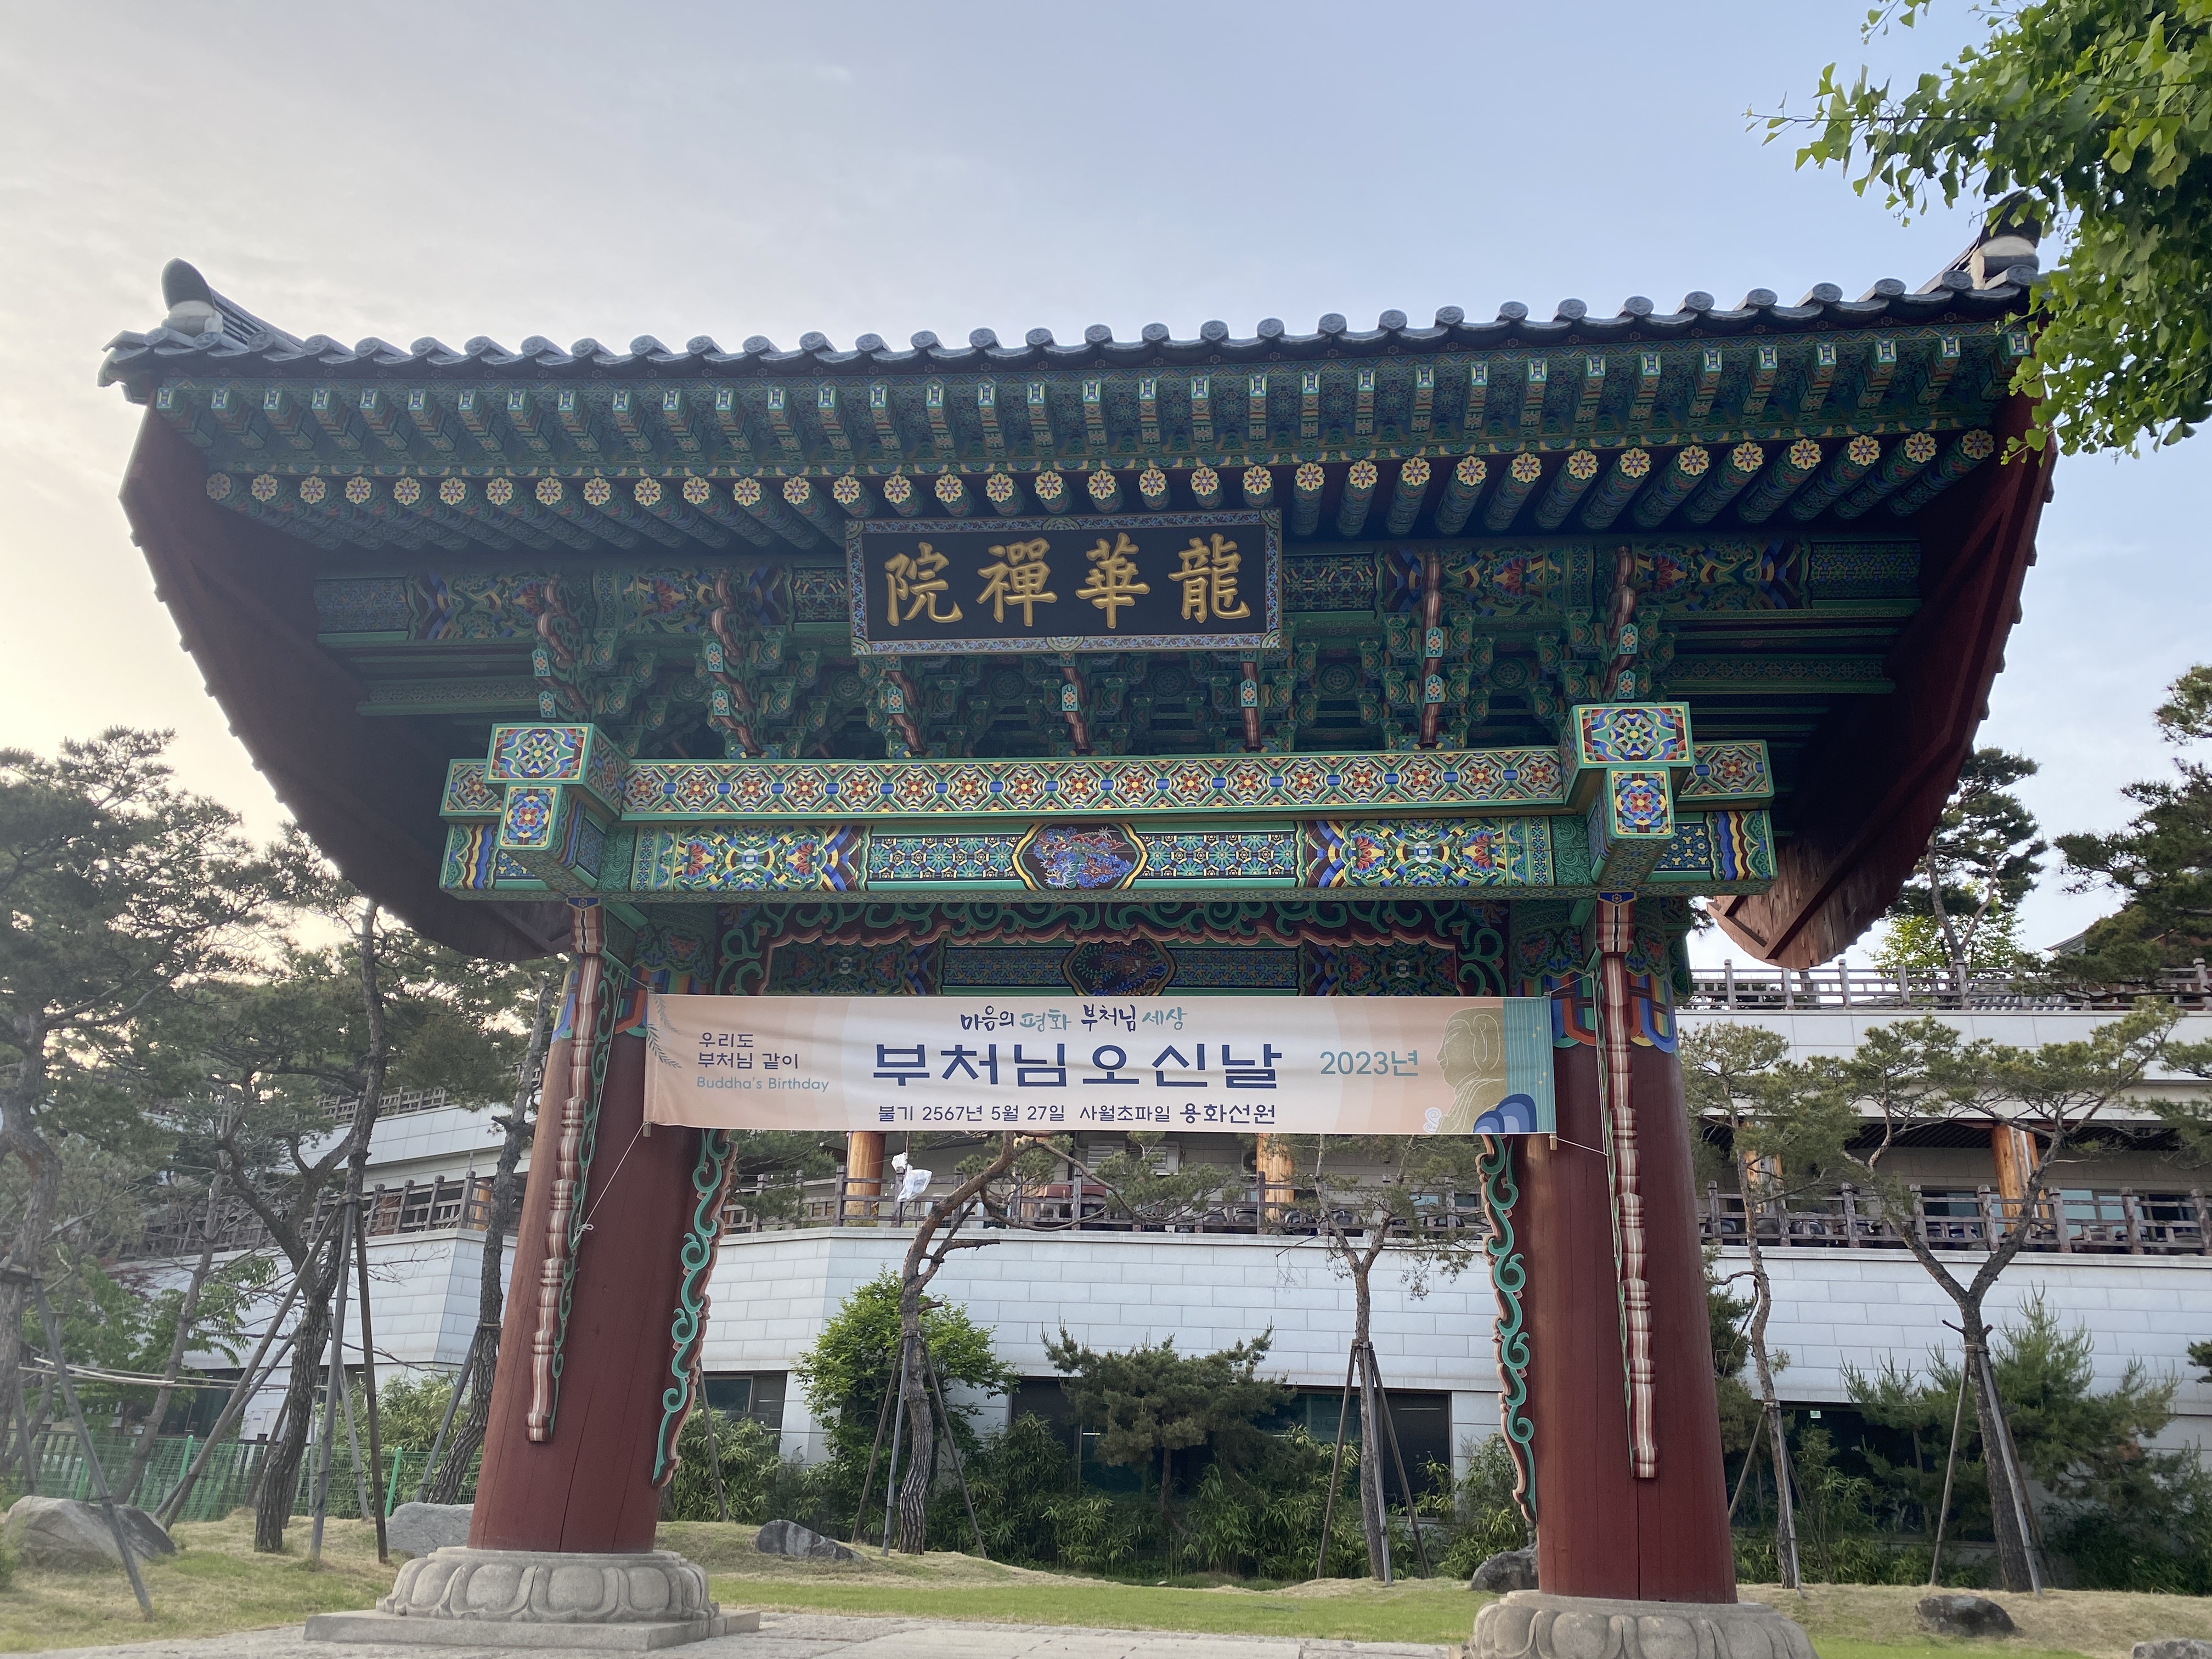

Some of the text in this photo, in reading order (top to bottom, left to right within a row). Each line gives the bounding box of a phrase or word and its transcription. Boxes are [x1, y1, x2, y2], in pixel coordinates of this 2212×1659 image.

[960, 1003, 1188, 1032] 마음의 평화 부처님 세상
[698, 1032, 754, 1048] 우리도
[697, 1052, 798, 1070] 부처님 같이
[1319, 1049, 1419, 1077] 2023년
[696, 1076, 830, 1093] Buddha's Birthday
[878, 1102, 1276, 1125] 불기 2567년 5월 27일 사월초파일 용화선원
